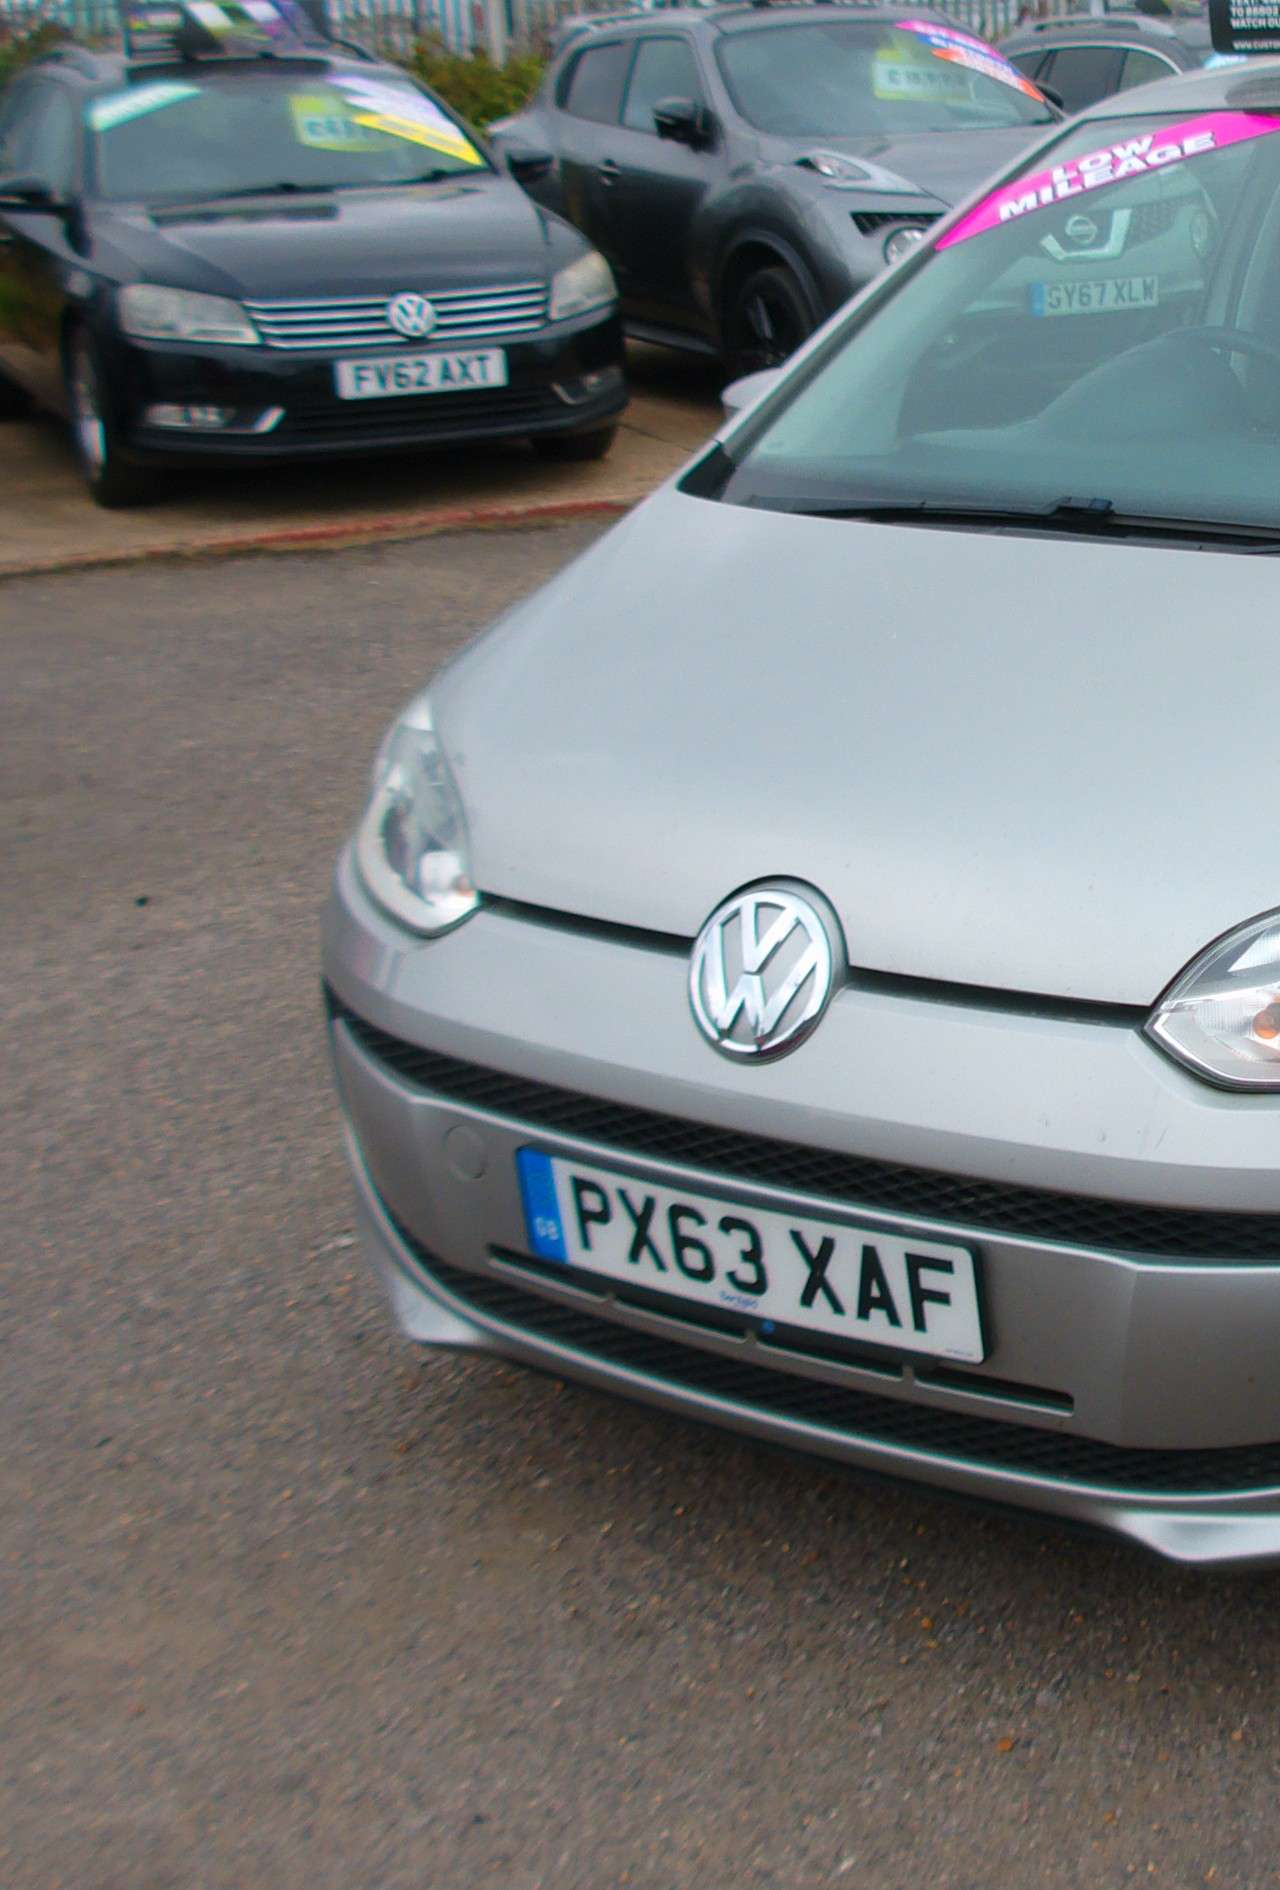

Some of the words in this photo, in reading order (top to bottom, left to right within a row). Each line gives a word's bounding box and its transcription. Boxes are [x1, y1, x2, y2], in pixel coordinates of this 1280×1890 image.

[1231, 6, 1244, 16] TO
[1231, 18, 1266, 29] WATCH
[1000, 131, 1216, 221] MILEAGE
[1052, 134, 1155, 183] LOW
[353, 360, 432, 392] FV62
[440, 354, 490, 385] AXT
[569, 1173, 769, 1296] PX63
[788, 1229, 955, 1333] XAF
